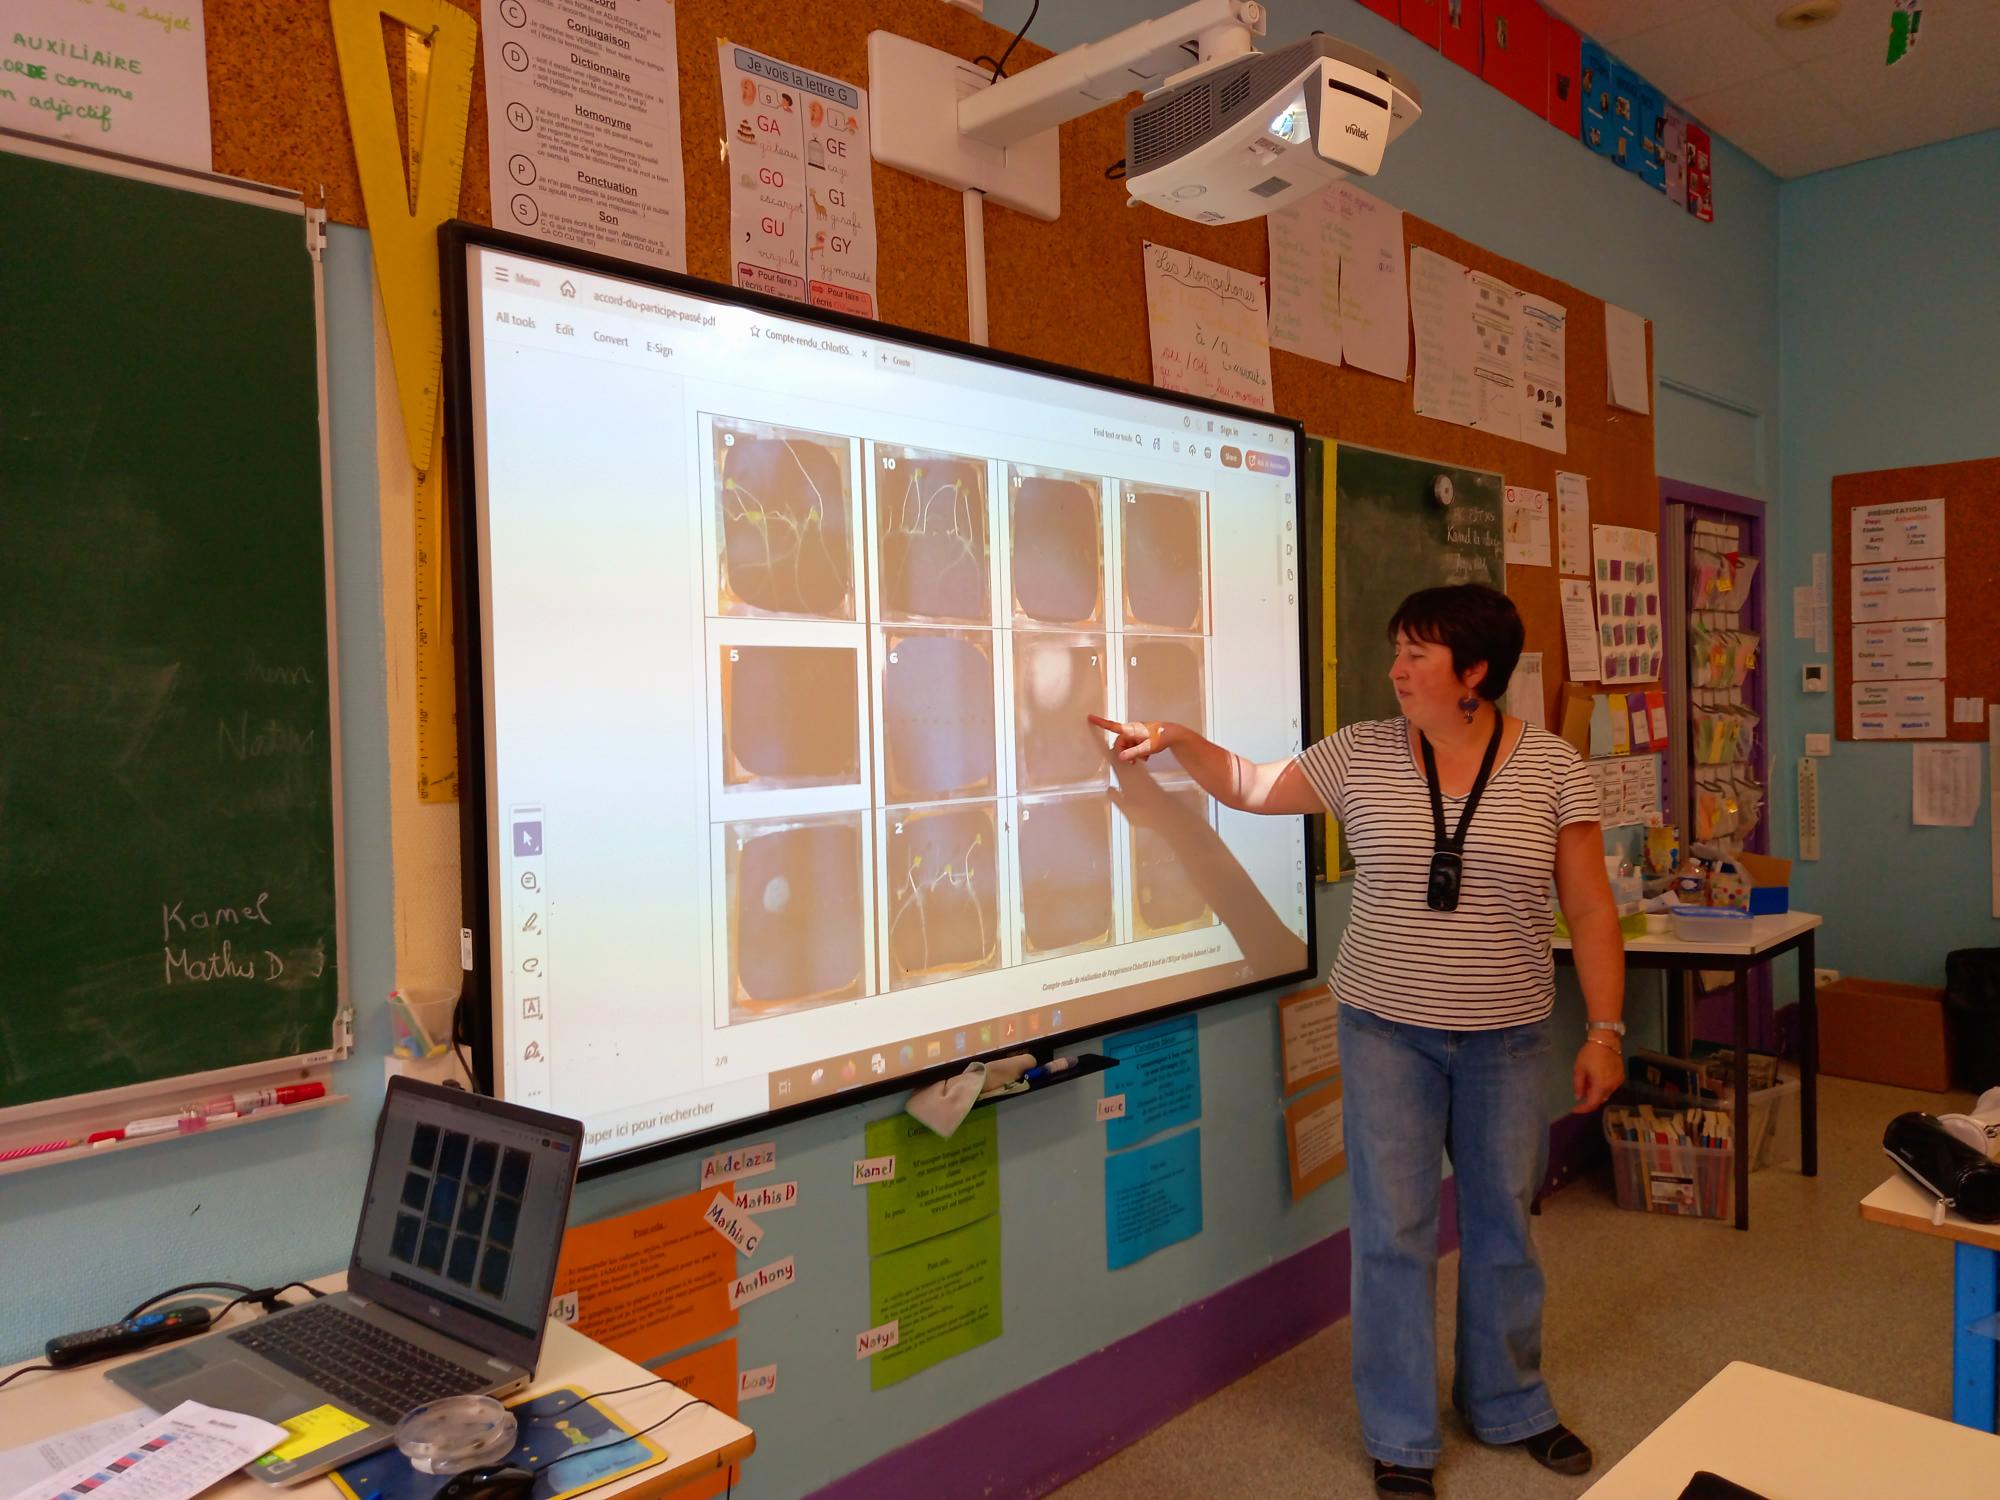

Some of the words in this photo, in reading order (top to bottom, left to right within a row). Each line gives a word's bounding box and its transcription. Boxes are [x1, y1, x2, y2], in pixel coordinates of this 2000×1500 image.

[137, 6, 191, 33] sujet
[509, 7, 518, 18] C
[567, 18, 630, 49] Conjugaison
[511, 50, 520, 62] D
[570, 53, 631, 81] Dictionnaire
[56, 72, 133, 100] comme
[747, 57, 761, 72] Je
[765, 63, 789, 82] vois
[792, 72, 803, 87] la
[806, 77, 835, 97] lettre
[838, 89, 848, 101] G
[29, 96, 112, 132] adjectif
[515, 112, 524, 123] H
[575, 104, 632, 131] Homonyme
[757, 115, 781, 136] GA
[1345, 124, 1369, 141] vivitek
[826, 138, 847, 158] GE
[518, 164, 525, 175] P
[577, 171, 638, 196] Ponctuation
[759, 167, 784, 188] GO
[828, 188, 846, 208] GI
[519, 204, 528, 215] S
[599, 211, 619, 225] Son
[761, 217, 785, 237] GU
[831, 236, 852, 254] GY
[515, 272, 541, 288] Menu
[758, 270, 775, 284] Pour
[776, 274, 791, 286] faire
[827, 287, 843, 299] Pour
[496, 312, 510, 324] All
[512, 315, 537, 329] tools
[555, 324, 575, 337] Edit
[593, 331, 629, 347] Convert
[646, 341, 674, 358] E-Sign
[724, 433, 735, 447] 9
[1093, 427, 1105, 438] Find
[1220, 424, 1233, 437] Sign
[882, 457, 896, 470] 10
[1013, 476, 1022, 488] 11
[1126, 493, 1137, 503] 12
[729, 649, 739, 662] 5
[889, 653, 898, 664] 6
[1091, 656, 1098, 666] 7
[894, 823, 903, 834] 2
[163, 892, 272, 942] Kamel
[165, 940, 255, 984] Mathis
[265, 950, 284, 982] D
[616, 1124, 629, 1137] ici
[632, 1119, 656, 1137] pour
[659, 1102, 715, 1125] rechercher
[704, 1150, 774, 1179] Abdelaziz
[855, 1160, 893, 1178] Kamel
[736, 1191, 782, 1210] Mathis
[785, 1184, 796, 1201] D
[707, 1203, 745, 1246] Mathis
[746, 1236, 758, 1251] C
[734, 1264, 794, 1299] Anthony
[741, 1373, 776, 1389] Loay
